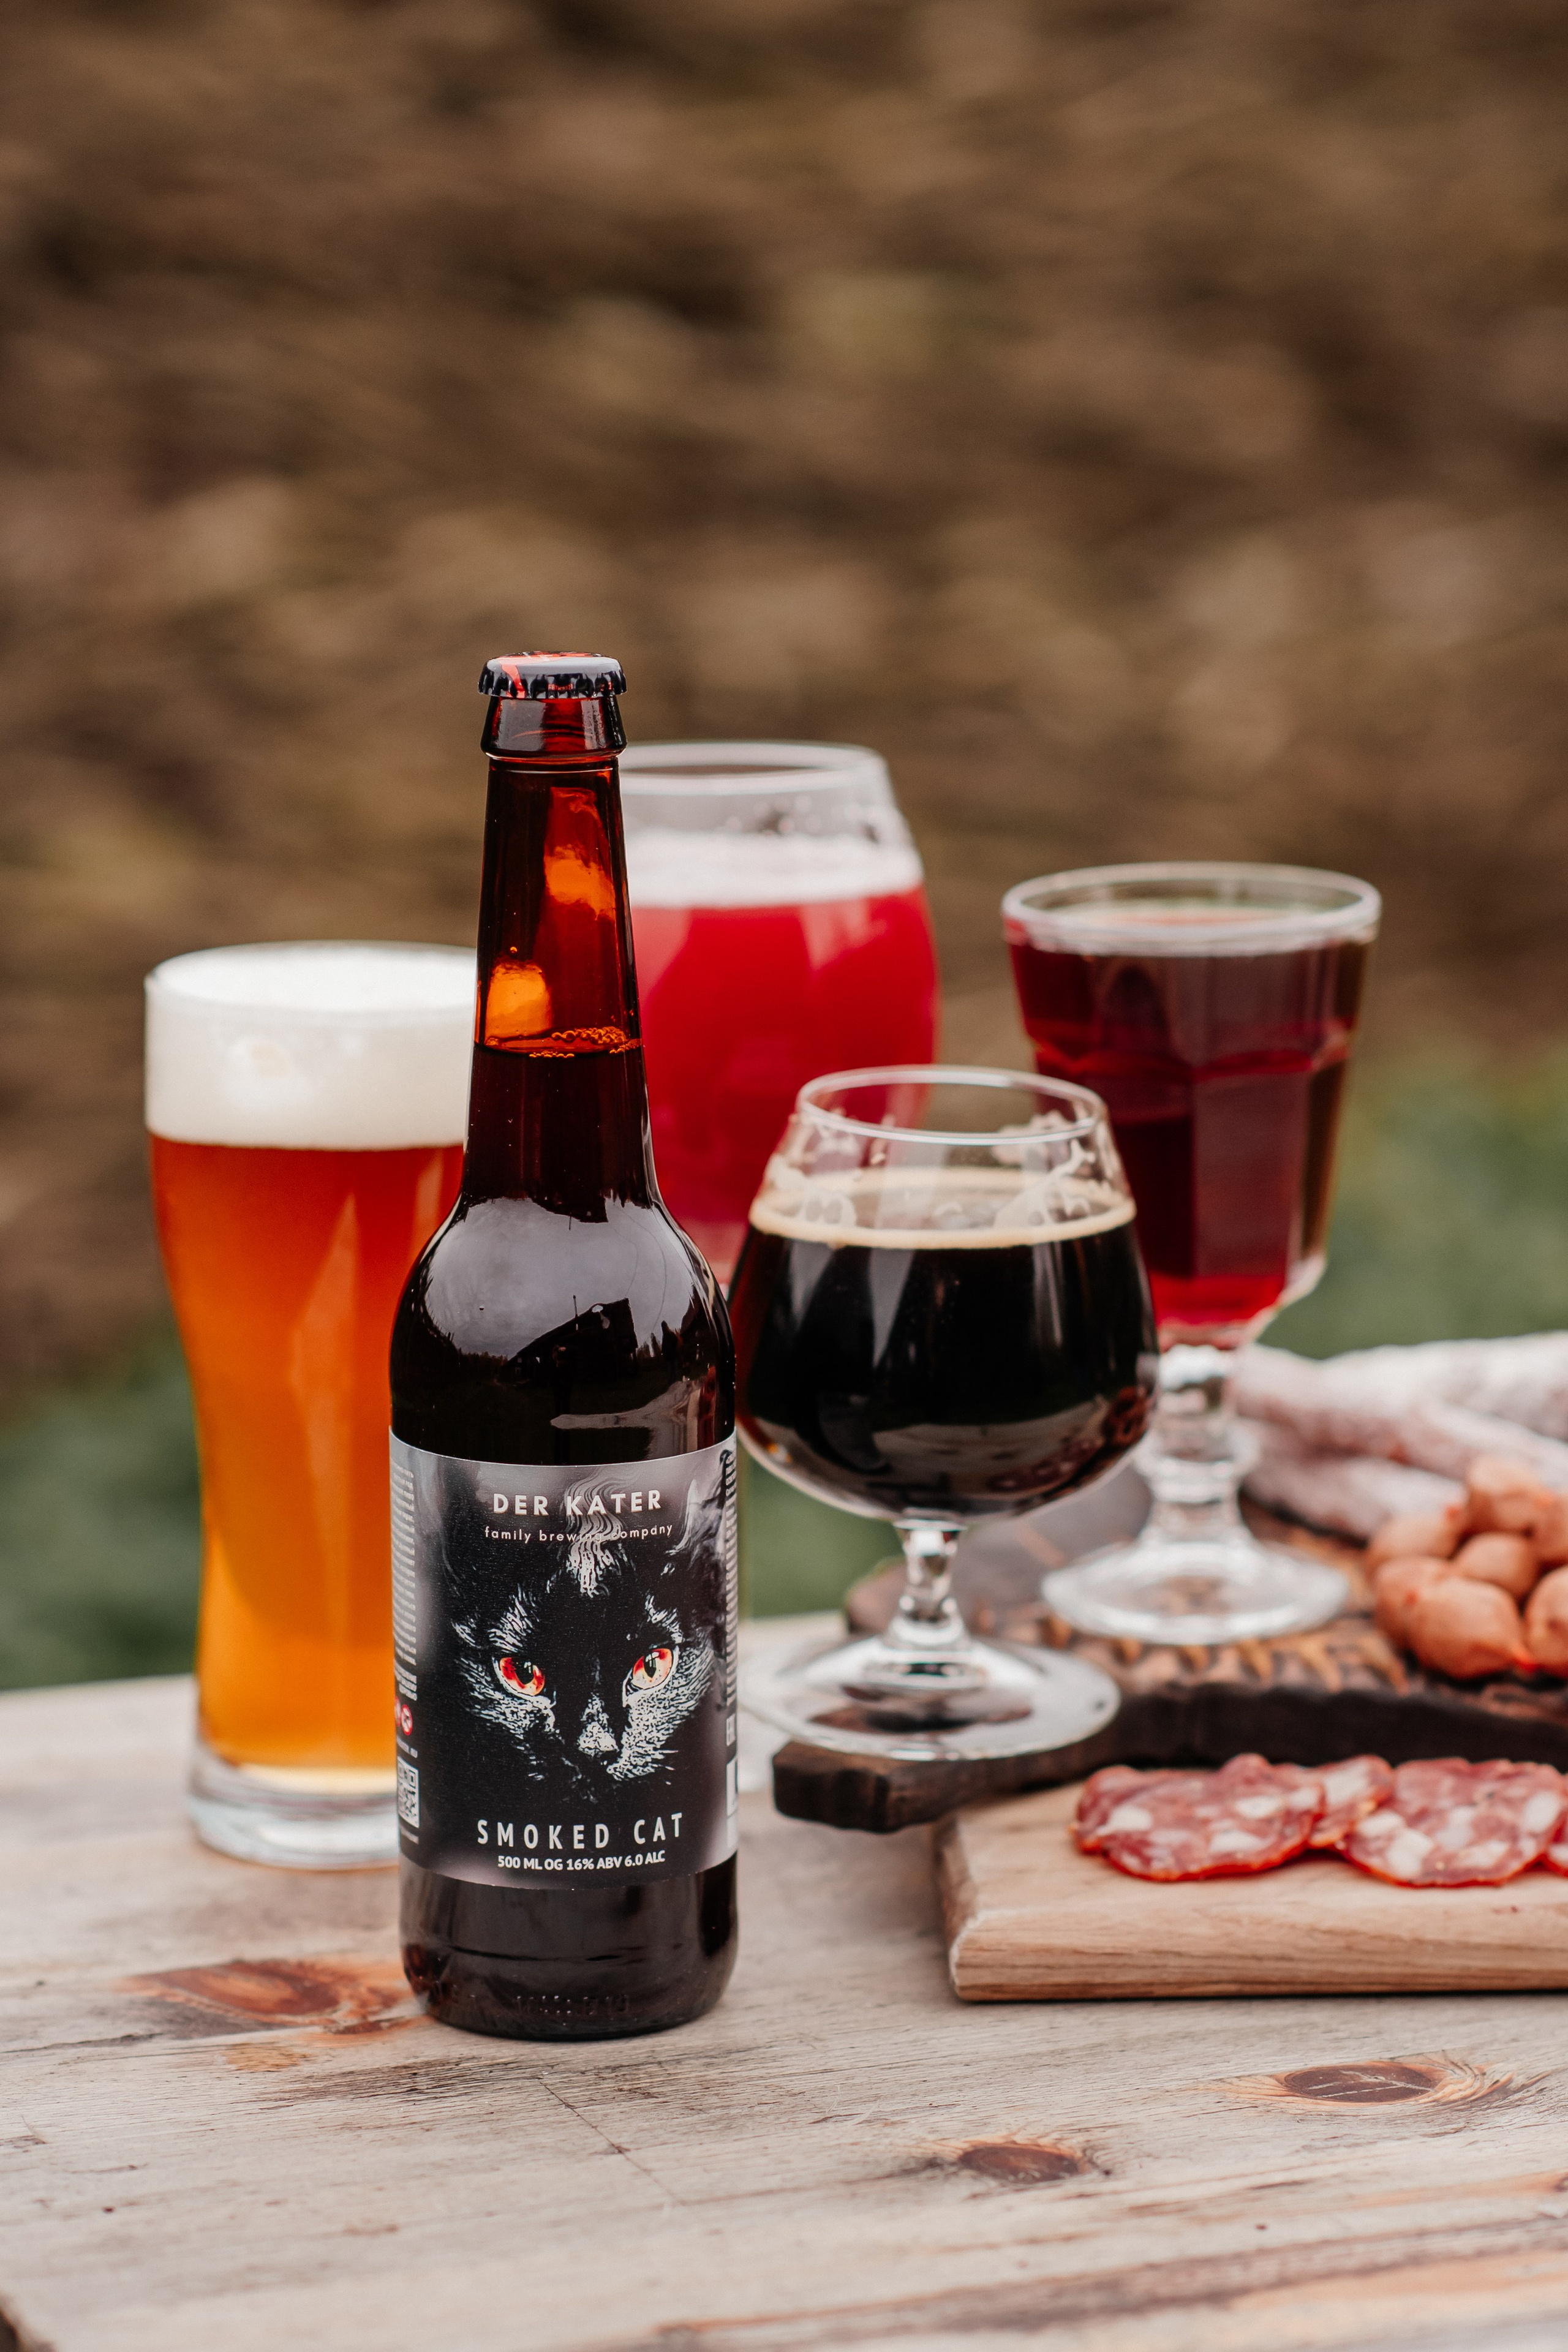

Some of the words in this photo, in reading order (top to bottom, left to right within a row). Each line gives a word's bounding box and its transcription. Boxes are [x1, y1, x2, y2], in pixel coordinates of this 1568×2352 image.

[493, 1493, 549, 1516] DER
[566, 1489, 662, 1516] KATER
[484, 1526, 532, 1544] family
[539, 1529, 602, 1544] brewing
[611, 1524, 673, 1540] company
[477, 1819, 610, 1850] SMOKED
[633, 1812, 683, 1845] CAT
[497, 1855, 521, 1869] 500
[523, 1857, 543, 1870] ML
[544, 1858, 564, 1871] OG
[566, 1858, 595, 1871] 16%
[596, 1856, 623, 1869] ABV
[624, 1853, 644, 1867] 6.0
[644, 1850, 666, 1865] ALC
